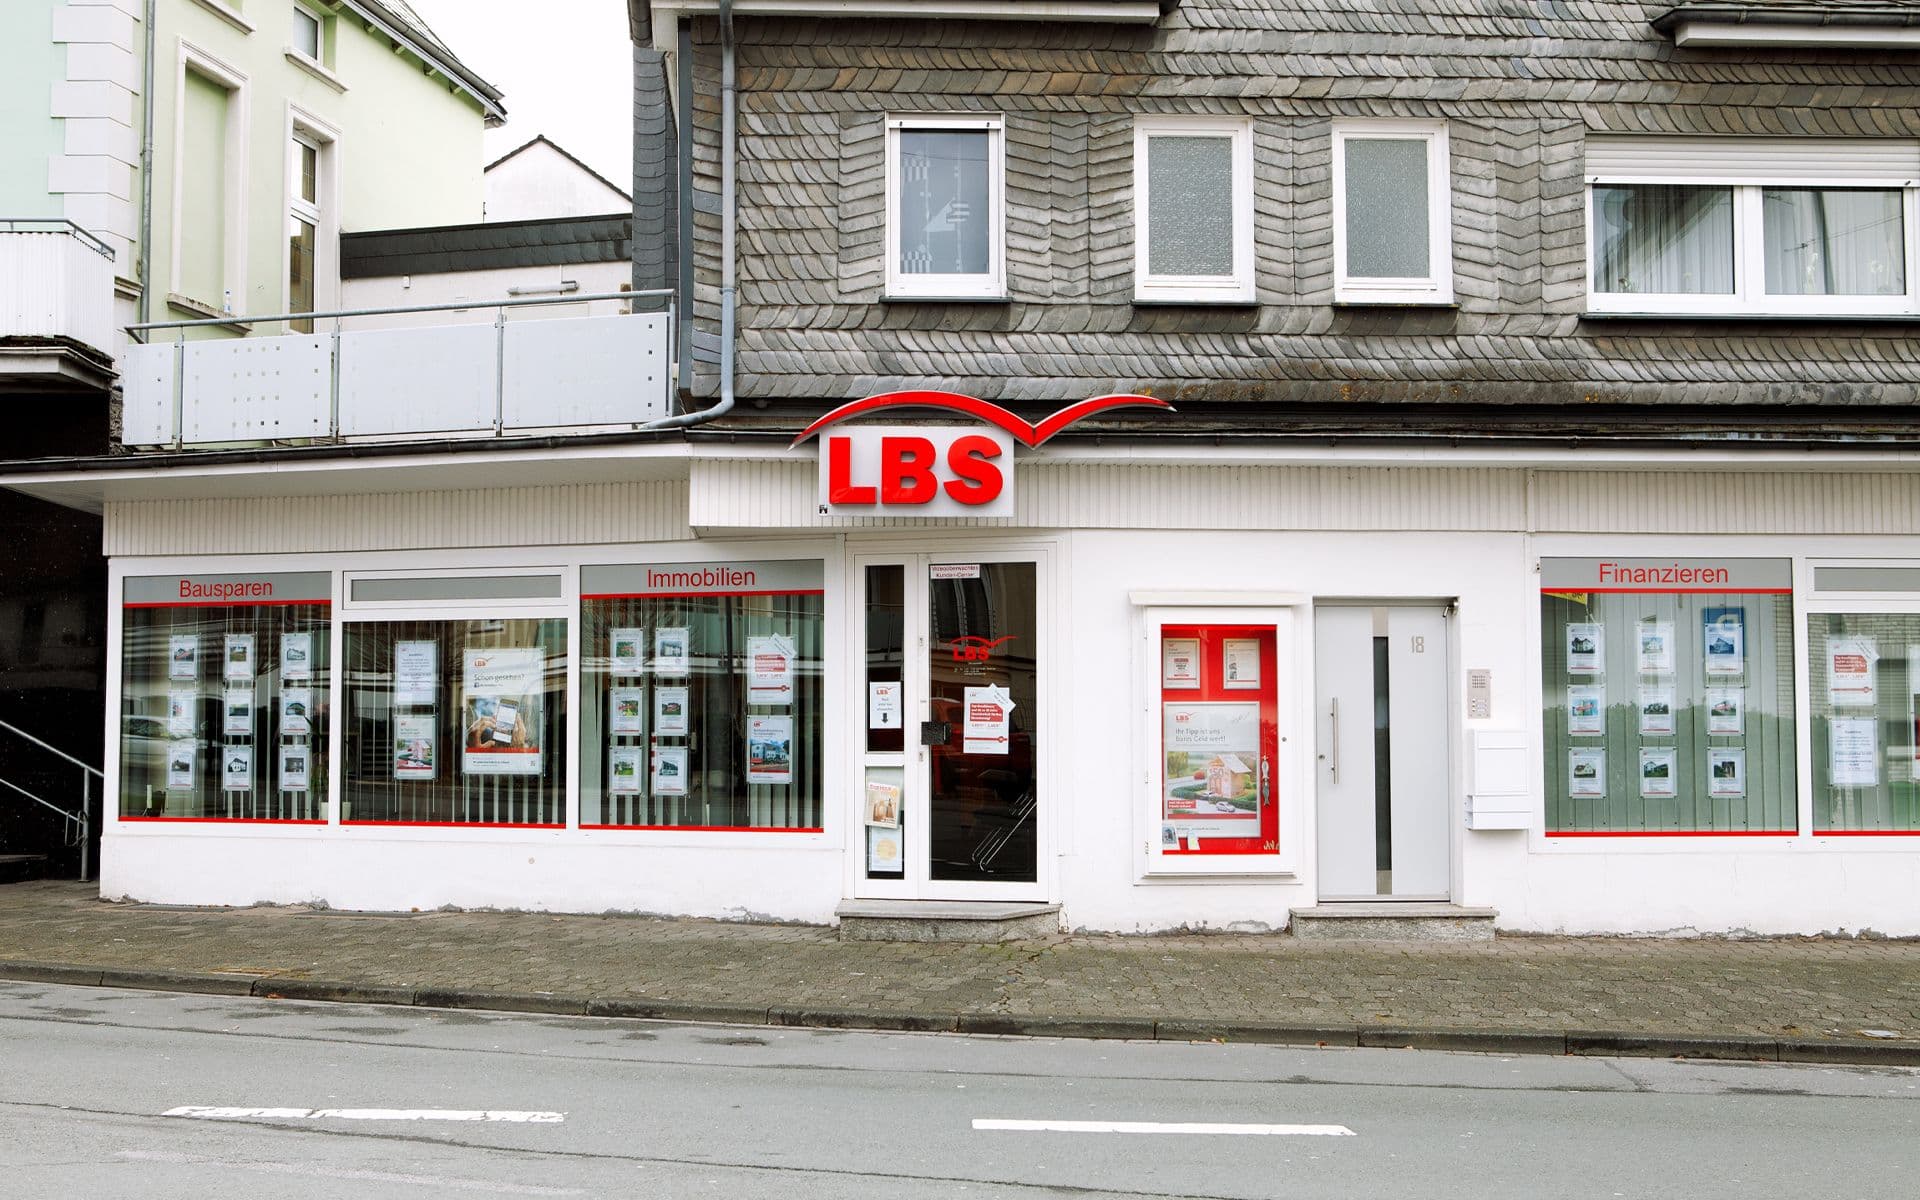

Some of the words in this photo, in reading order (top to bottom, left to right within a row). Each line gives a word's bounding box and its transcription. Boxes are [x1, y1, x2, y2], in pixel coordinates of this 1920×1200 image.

[828, 435, 1004, 506] LBS
[647, 567, 755, 588] Immobilien
[1599, 563, 1729, 583] Finanzieren
[180, 580, 273, 600] Bausparen
[953, 645, 990, 661] LBS
[1411, 636, 1425, 653] 18
[1185, 728, 1198, 736] Tipp
